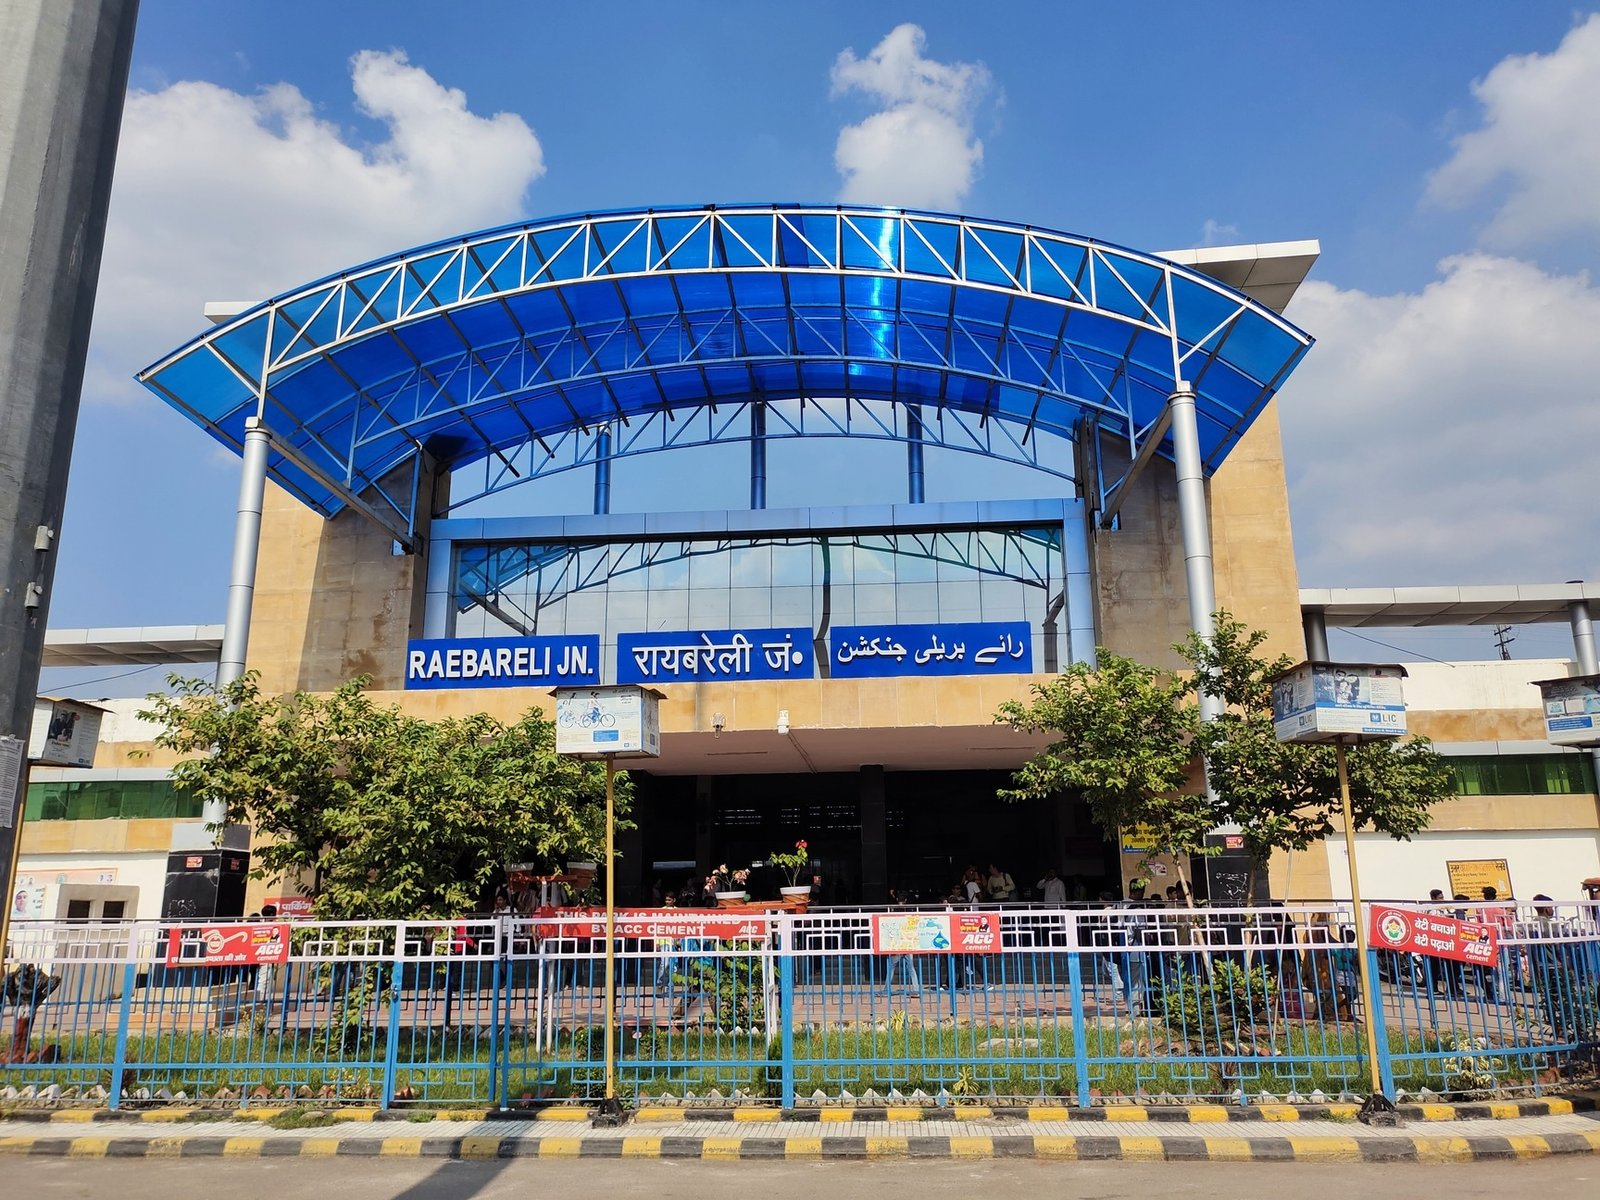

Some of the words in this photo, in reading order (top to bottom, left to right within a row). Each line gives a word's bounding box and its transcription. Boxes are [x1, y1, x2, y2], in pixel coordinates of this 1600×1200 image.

[632, 633, 753, 676] रायबरेली
[837, 635, 907, 663] جنکشن
[409, 646, 551, 679] RAEBARELI
[557, 645, 593, 675] JN.
[1382, 714, 1397, 723] LIC
[614, 924, 643, 934] ACC
[646, 925, 706, 935] CEMENT
[1414, 917, 1429, 931] बेटी
[1430, 921, 1457, 936] बचाओ
[962, 933, 994, 945] ACC
[1414, 933, 1429, 947] बेटी
[1430, 938, 1455, 952] पढ़ाओ
[255, 943, 284, 956] ACC
[1463, 943, 1493, 956] ACC
[1466, 953, 1489, 962] cement
